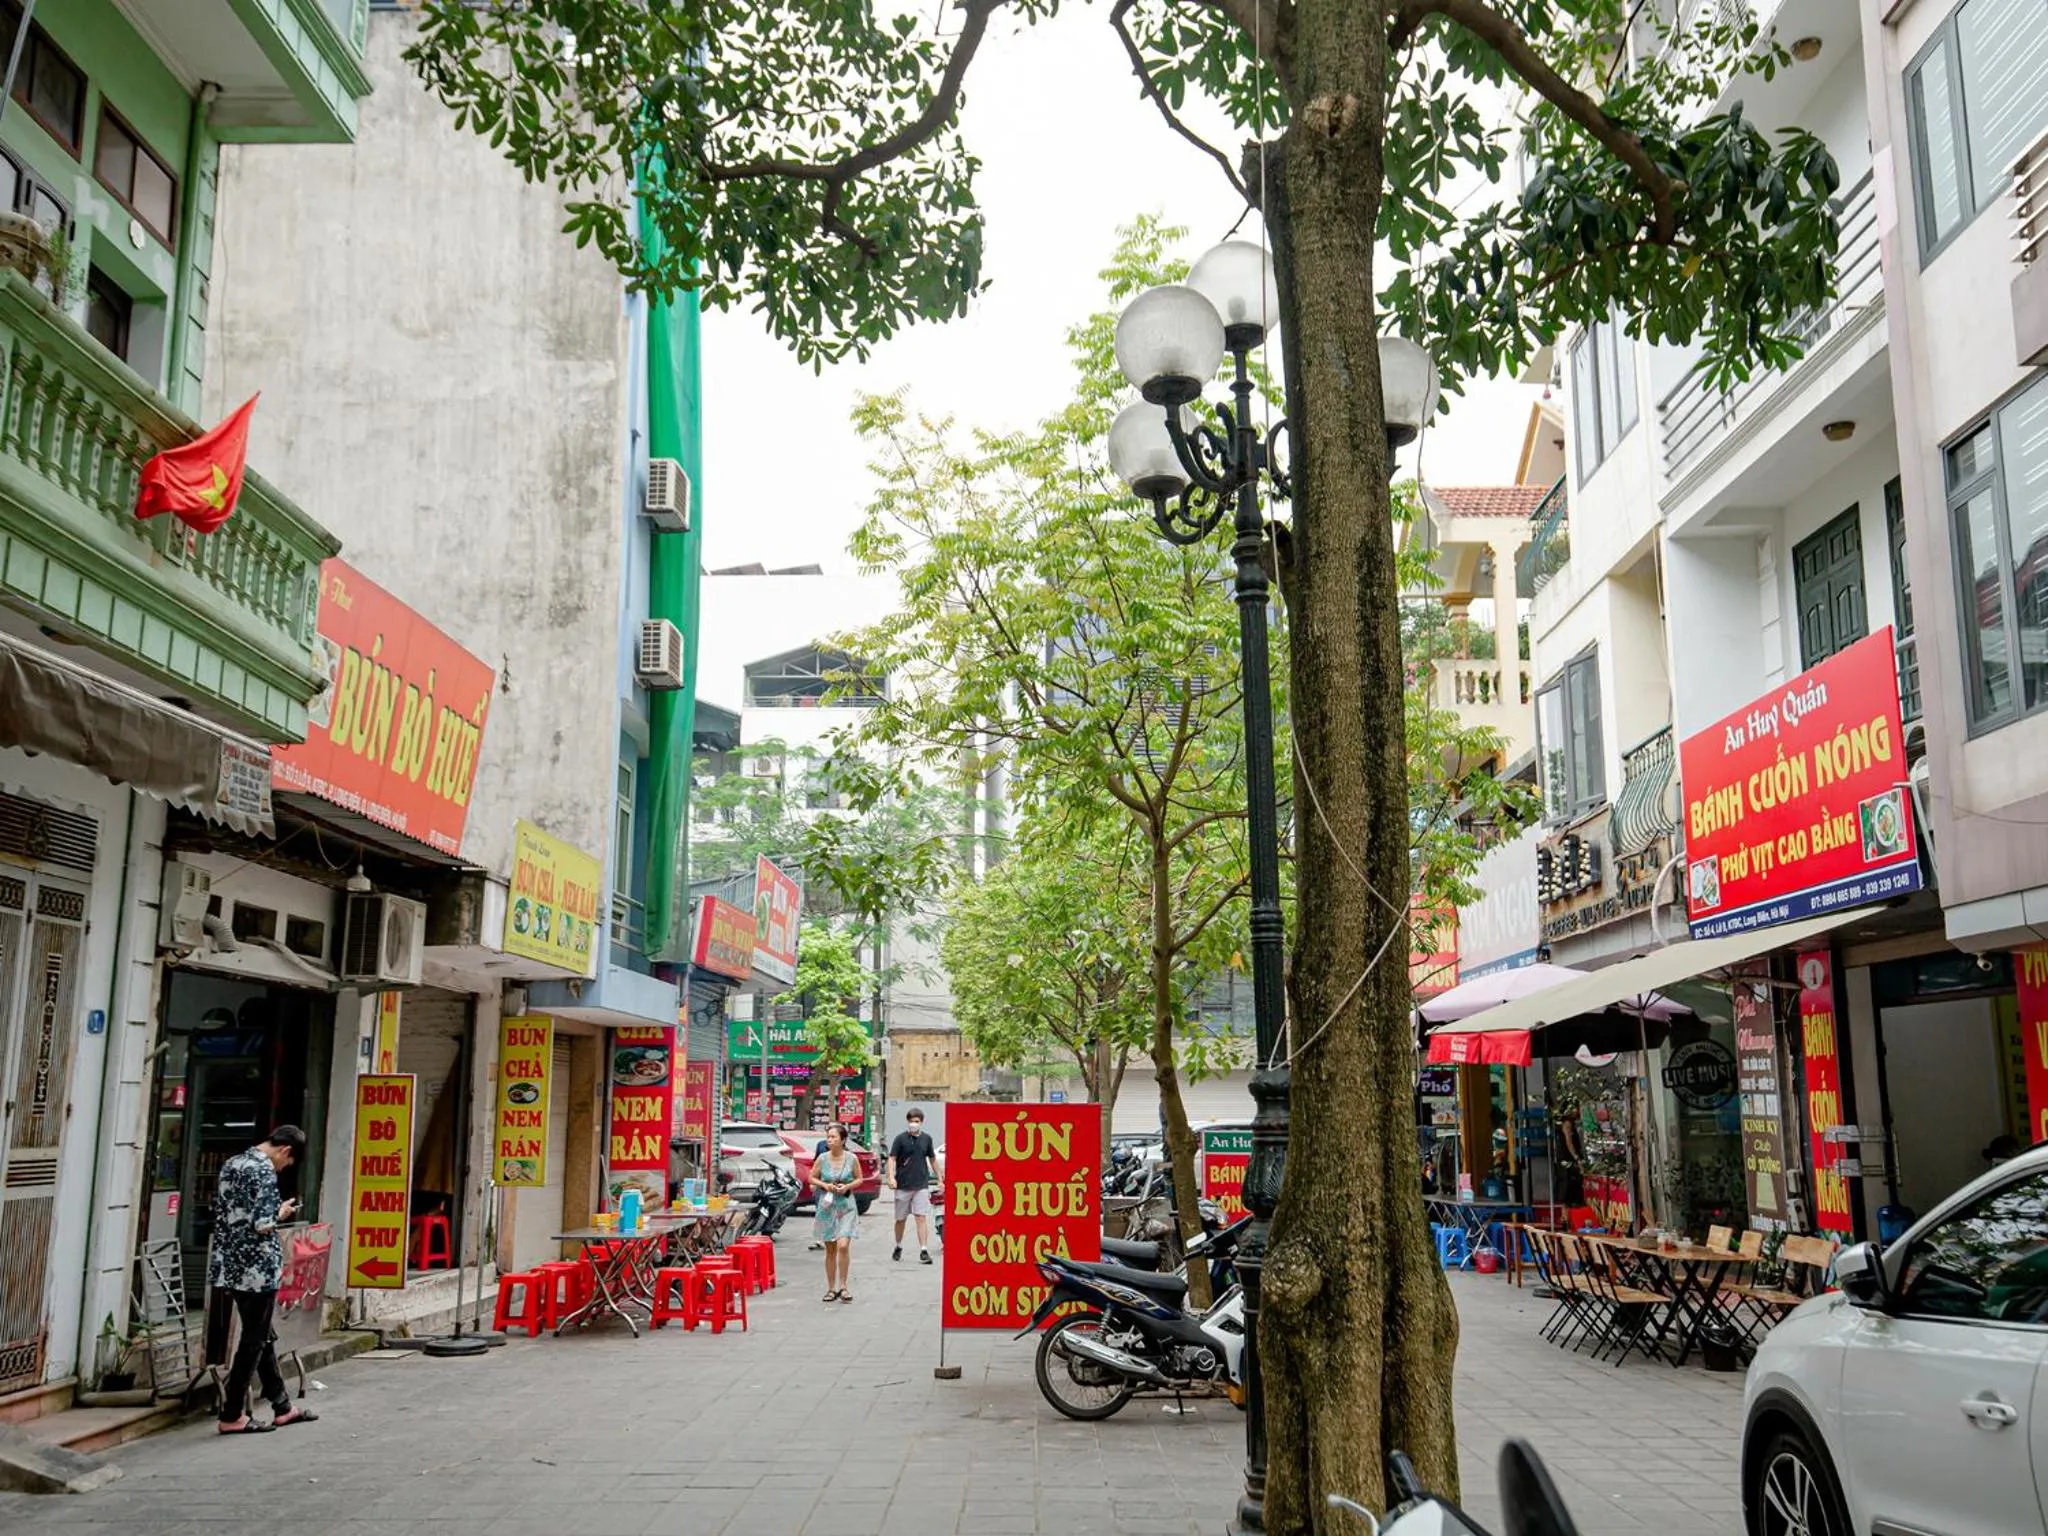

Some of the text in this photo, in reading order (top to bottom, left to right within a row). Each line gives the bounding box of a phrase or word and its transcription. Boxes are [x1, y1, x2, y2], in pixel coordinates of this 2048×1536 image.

[330, 633, 489, 807] BÚN BÒ HUẾ
[1724, 679, 1828, 755] An Huy Quán
[1690, 715, 1892, 840] BÁNH CUỐN NÓNG
[1721, 805, 1857, 884] PHỞ VỊT CAO BẰNG
[506, 1024, 546, 1047] BÚN
[769, 1024, 791, 1041] HẢI
[1803, 1004, 1834, 1060] BÁNH
[506, 1053, 544, 1078] CHẢ
[1664, 1067, 1695, 1087] LIVE
[362, 1081, 406, 1106] BÚN
[1421, 1079, 1451, 1092] Phố
[613, 1096, 663, 1122] NEM
[1810, 1070, 1838, 1133] CUỐN
[369, 1117, 396, 1141] BÒ
[503, 1110, 542, 1127] NEM
[501, 1140, 541, 1158] RÁN
[611, 1128, 662, 1161] RÁN
[971, 1112, 1073, 1161] BÚN
[1210, 1136, 1252, 1148] An Hu
[360, 1149, 402, 1176] HUẾ
[360, 1191, 405, 1212] ANH
[954, 1167, 1090, 1217] BÒ HUẾ
[356, 1227, 400, 1248] THƯ
[970, 1226, 1072, 1264] CƠM GÀ
[952, 1281, 1008, 1316] CƠM
